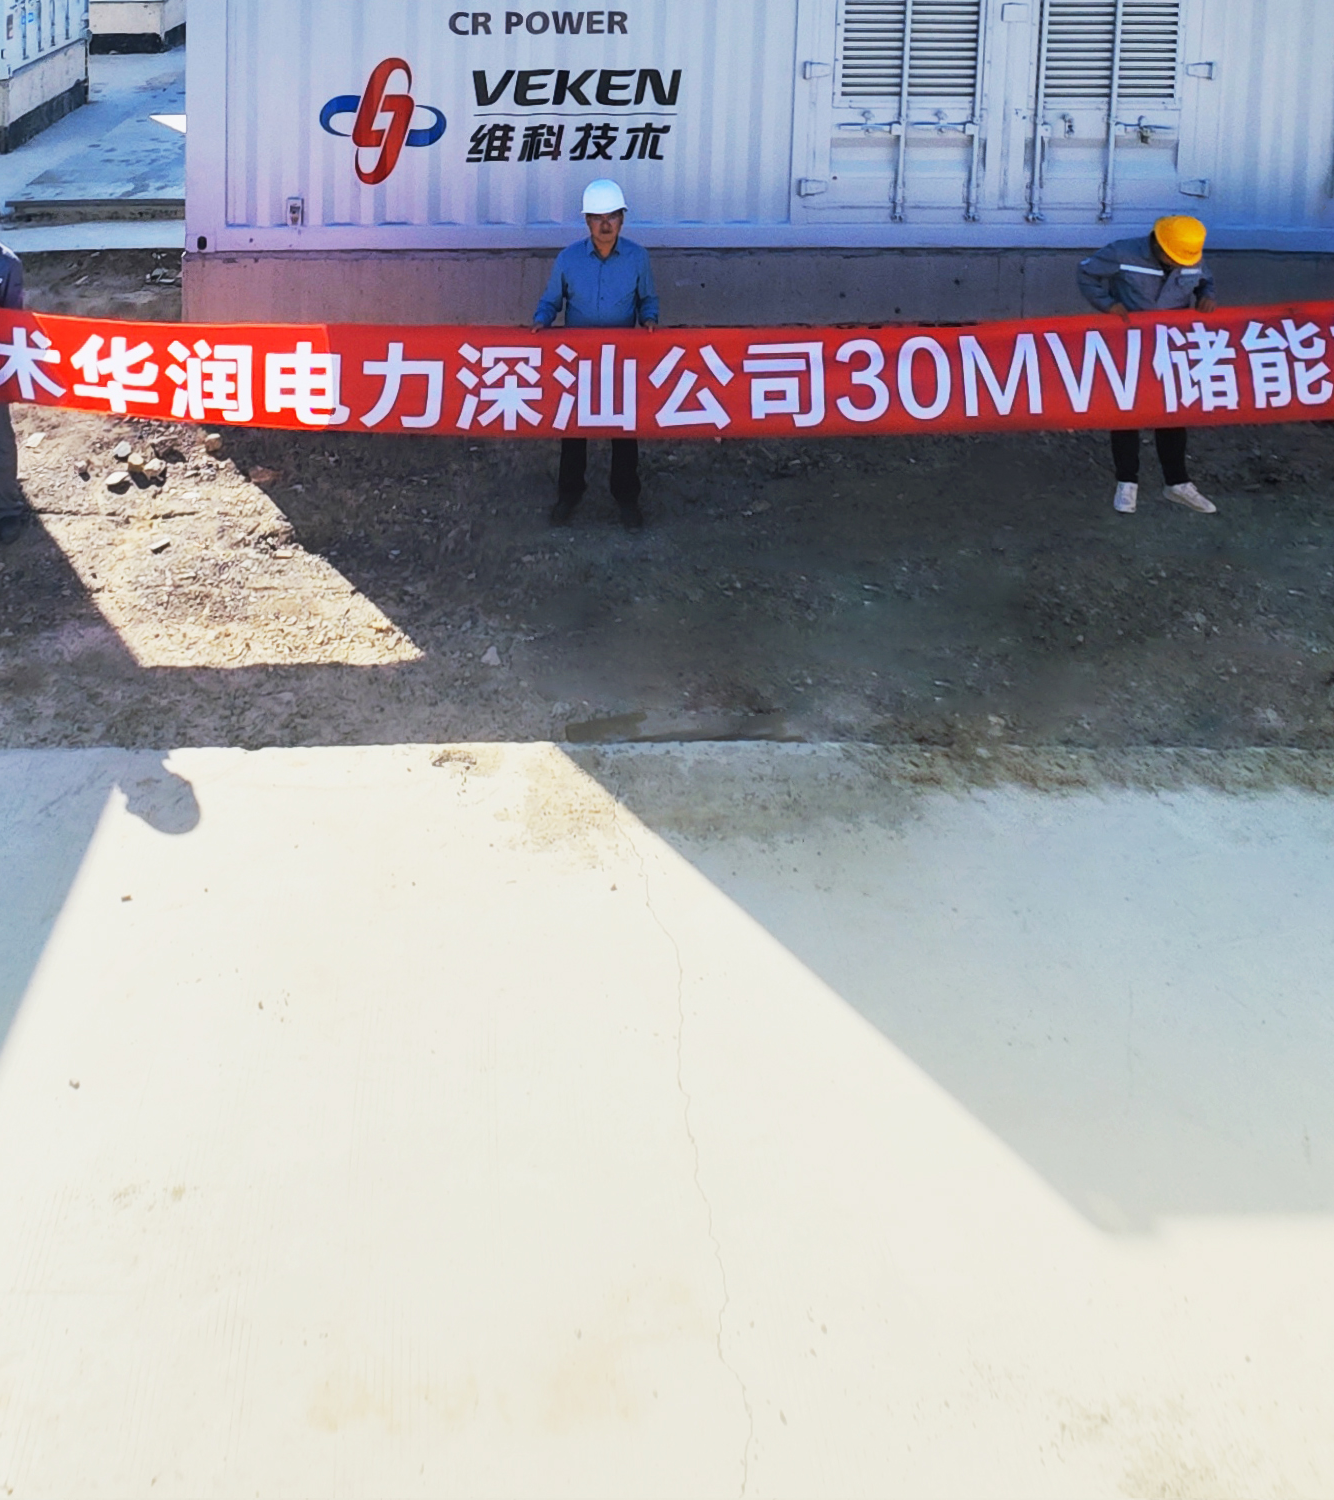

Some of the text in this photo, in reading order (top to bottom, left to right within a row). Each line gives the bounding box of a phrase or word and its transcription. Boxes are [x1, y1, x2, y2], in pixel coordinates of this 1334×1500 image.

[448, 10, 628, 36] CR POWER
[472, 68, 682, 107] VEKEN
[465, 122, 671, 163] 维科技术
